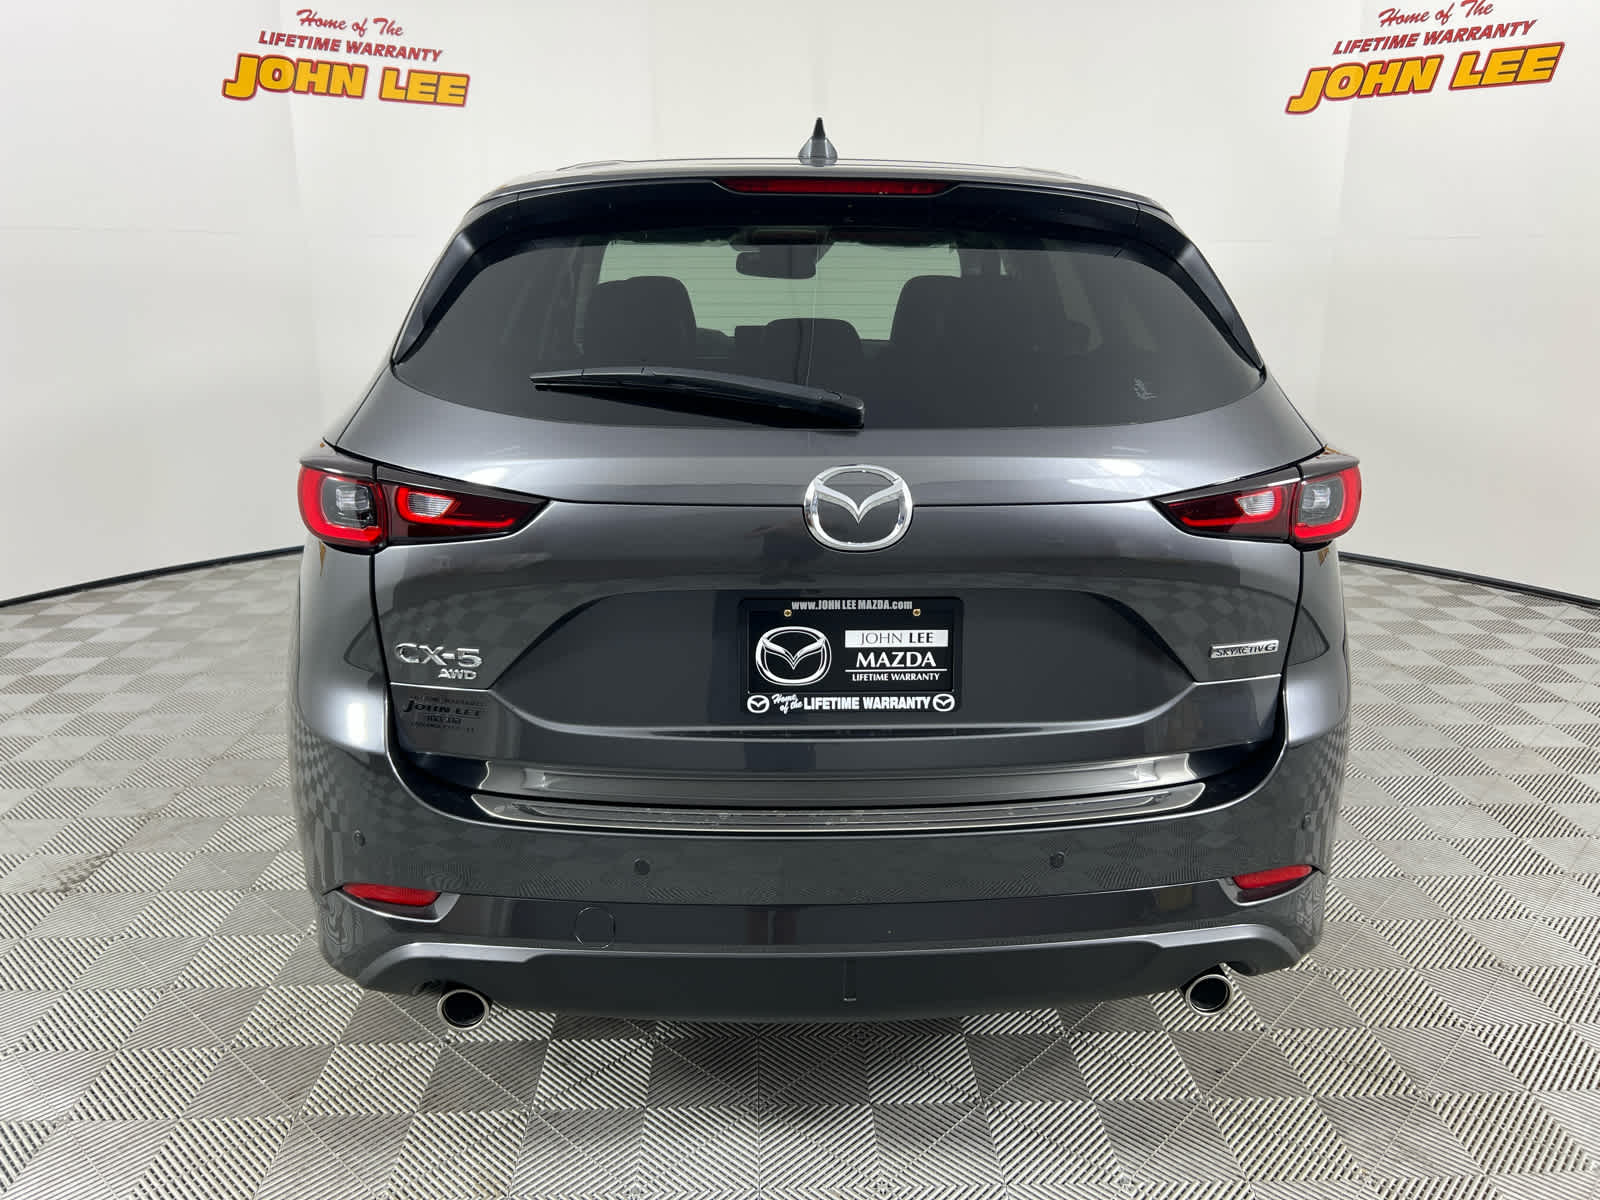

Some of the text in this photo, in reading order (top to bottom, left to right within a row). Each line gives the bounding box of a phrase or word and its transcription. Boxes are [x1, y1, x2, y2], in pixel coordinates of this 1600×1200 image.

[296, 9, 403, 37] Home of The
[1378, 0, 1493, 27] Home of The
[258, 30, 443, 62] LIFETIME WARRANTY
[1332, 19, 1537, 55] LIFETIME WARRANTY
[222, 53, 470, 107] JOHN LEE
[1285, 42, 1565, 115] JOHN LEE
[861, 631, 934, 645] JOHN LEE
[394, 643, 482, 667] CX-5
[855, 651, 937, 668] MAZDA
[438, 668, 477, 680] AWD
[852, 672, 940, 682] LIFETIME WARRANTY
[803, 697, 931, 710] LIFETIME WARRANTY
